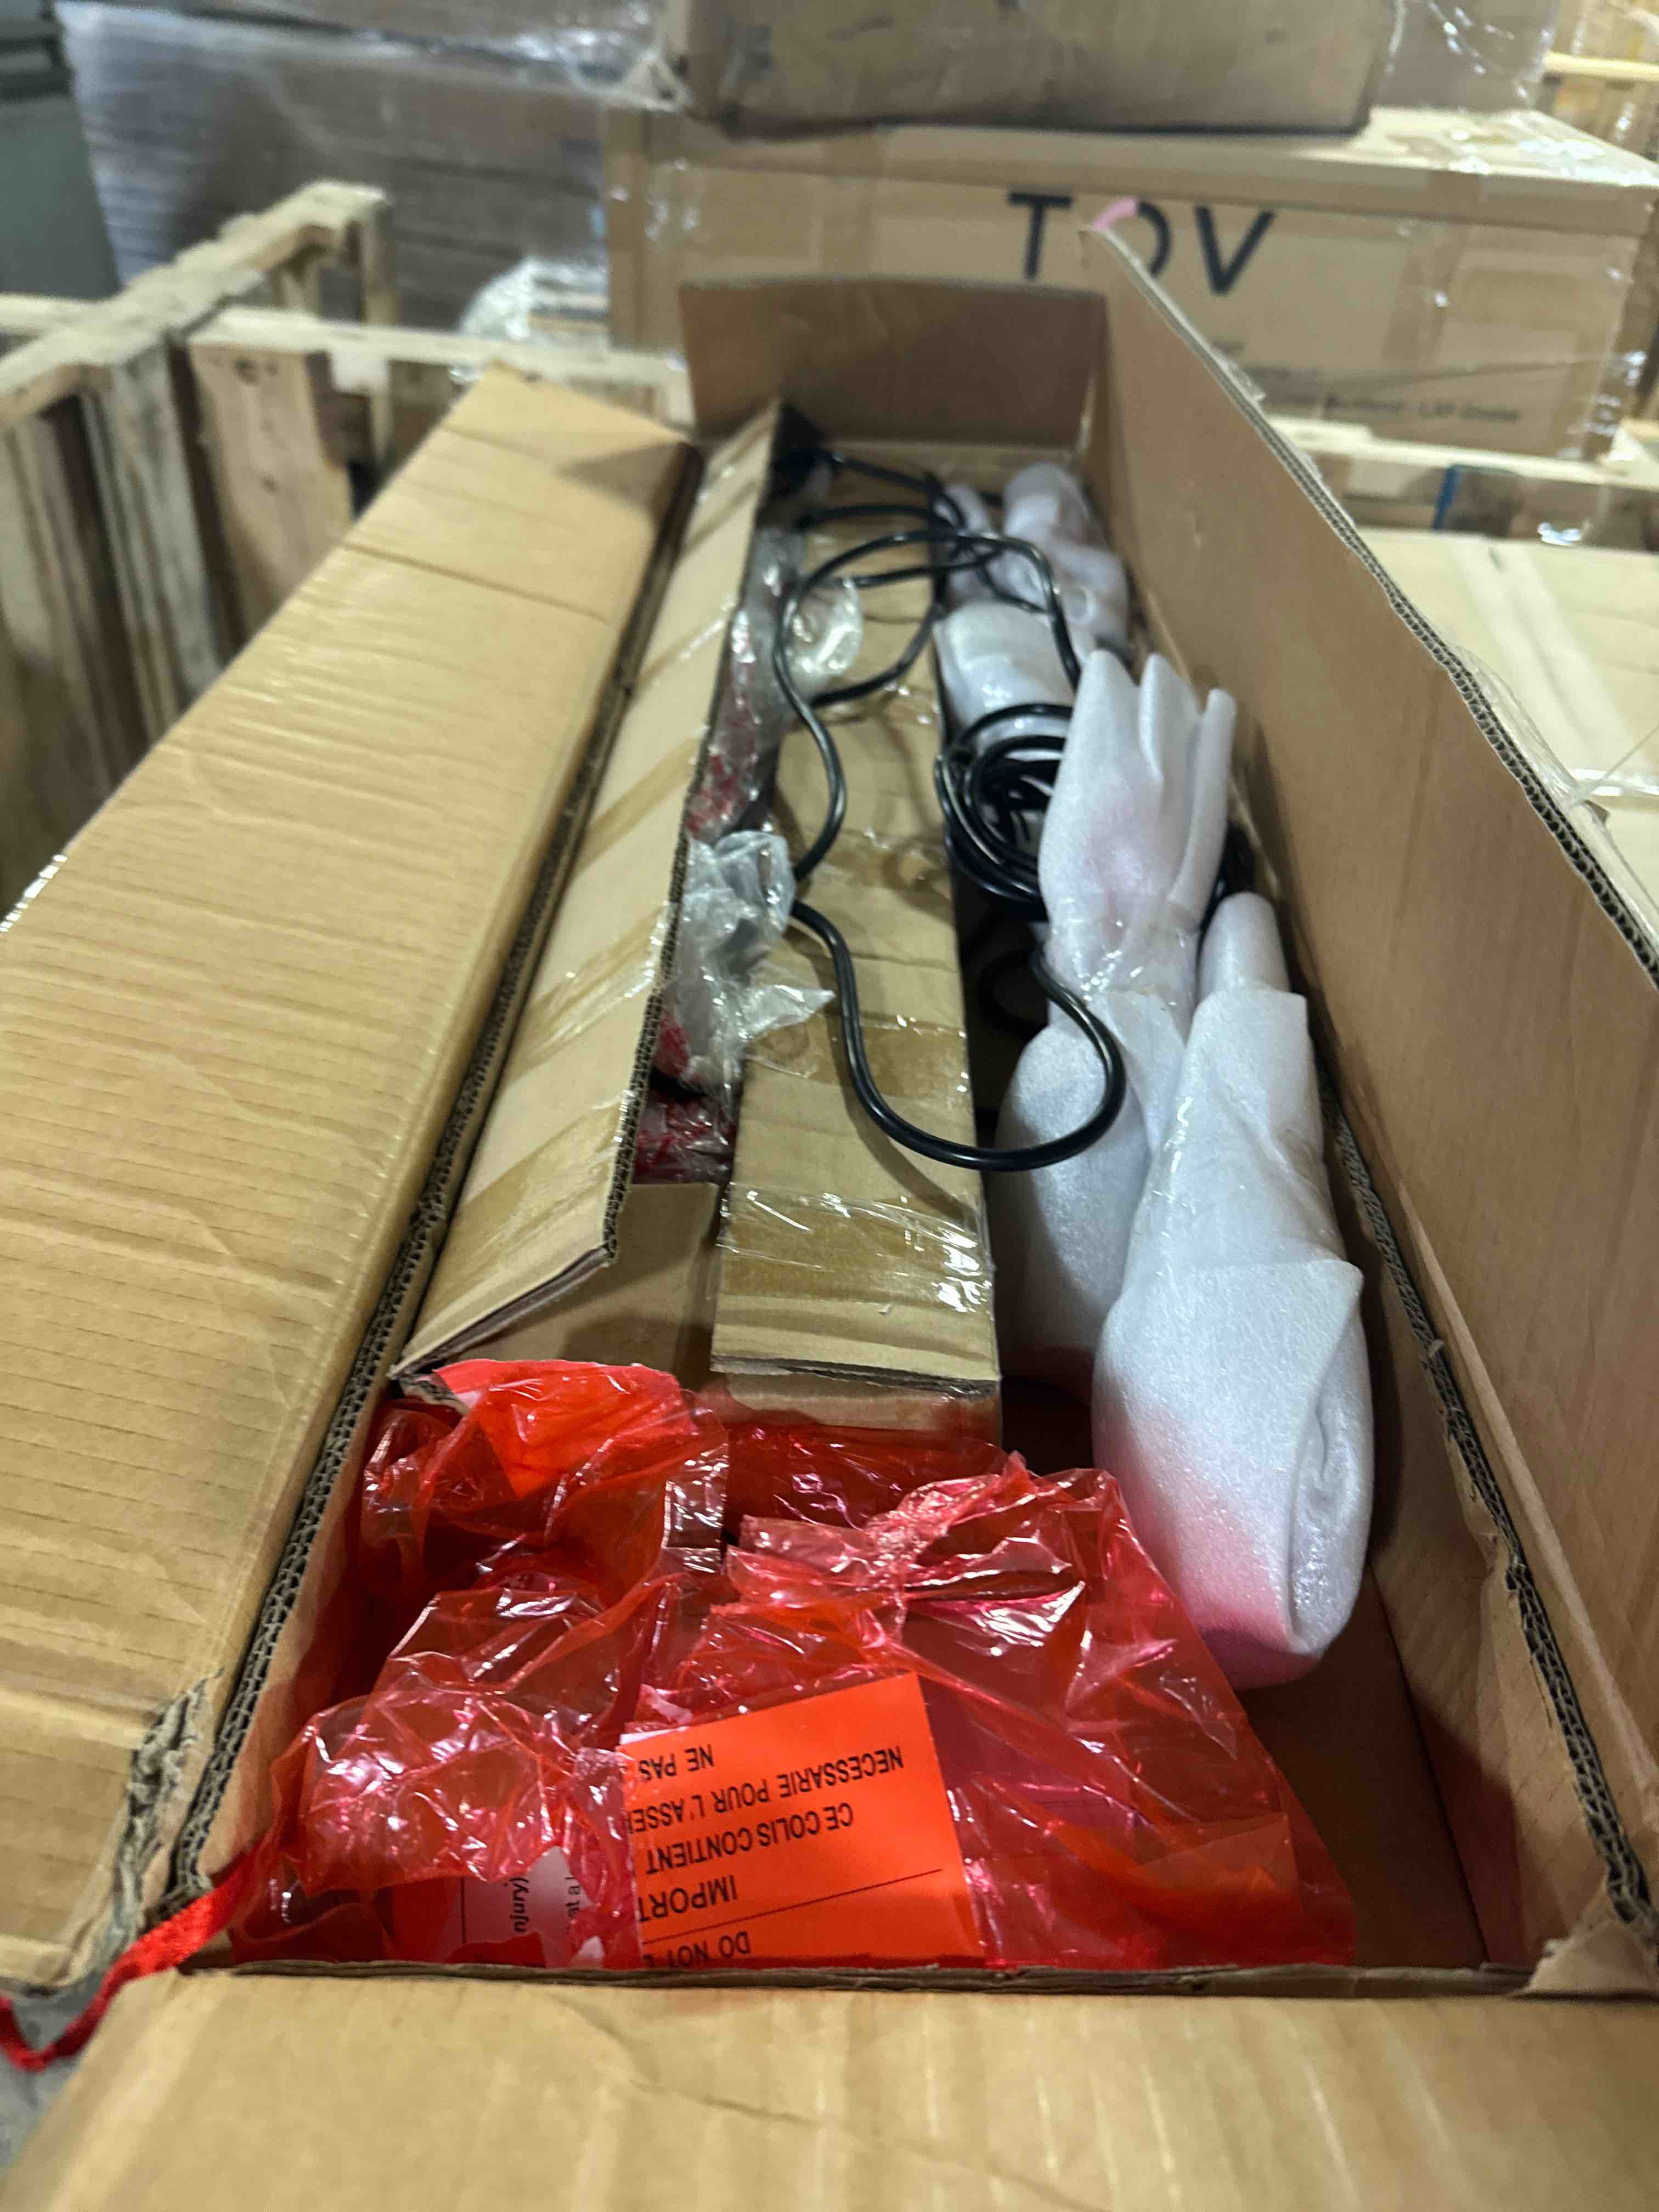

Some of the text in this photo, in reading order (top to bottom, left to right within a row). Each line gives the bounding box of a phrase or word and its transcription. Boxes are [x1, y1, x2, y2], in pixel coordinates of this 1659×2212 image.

[638, 1744, 714, 1781] NE PAS
[776, 1745, 904, 1798] NECESSARIE
[710, 1778, 770, 1813] POUR
[646, 1802, 854, 1875] CE COLIS CONTIENT
[666, 1940, 711, 1968] NOT
[718, 1931, 751, 1959] DO
